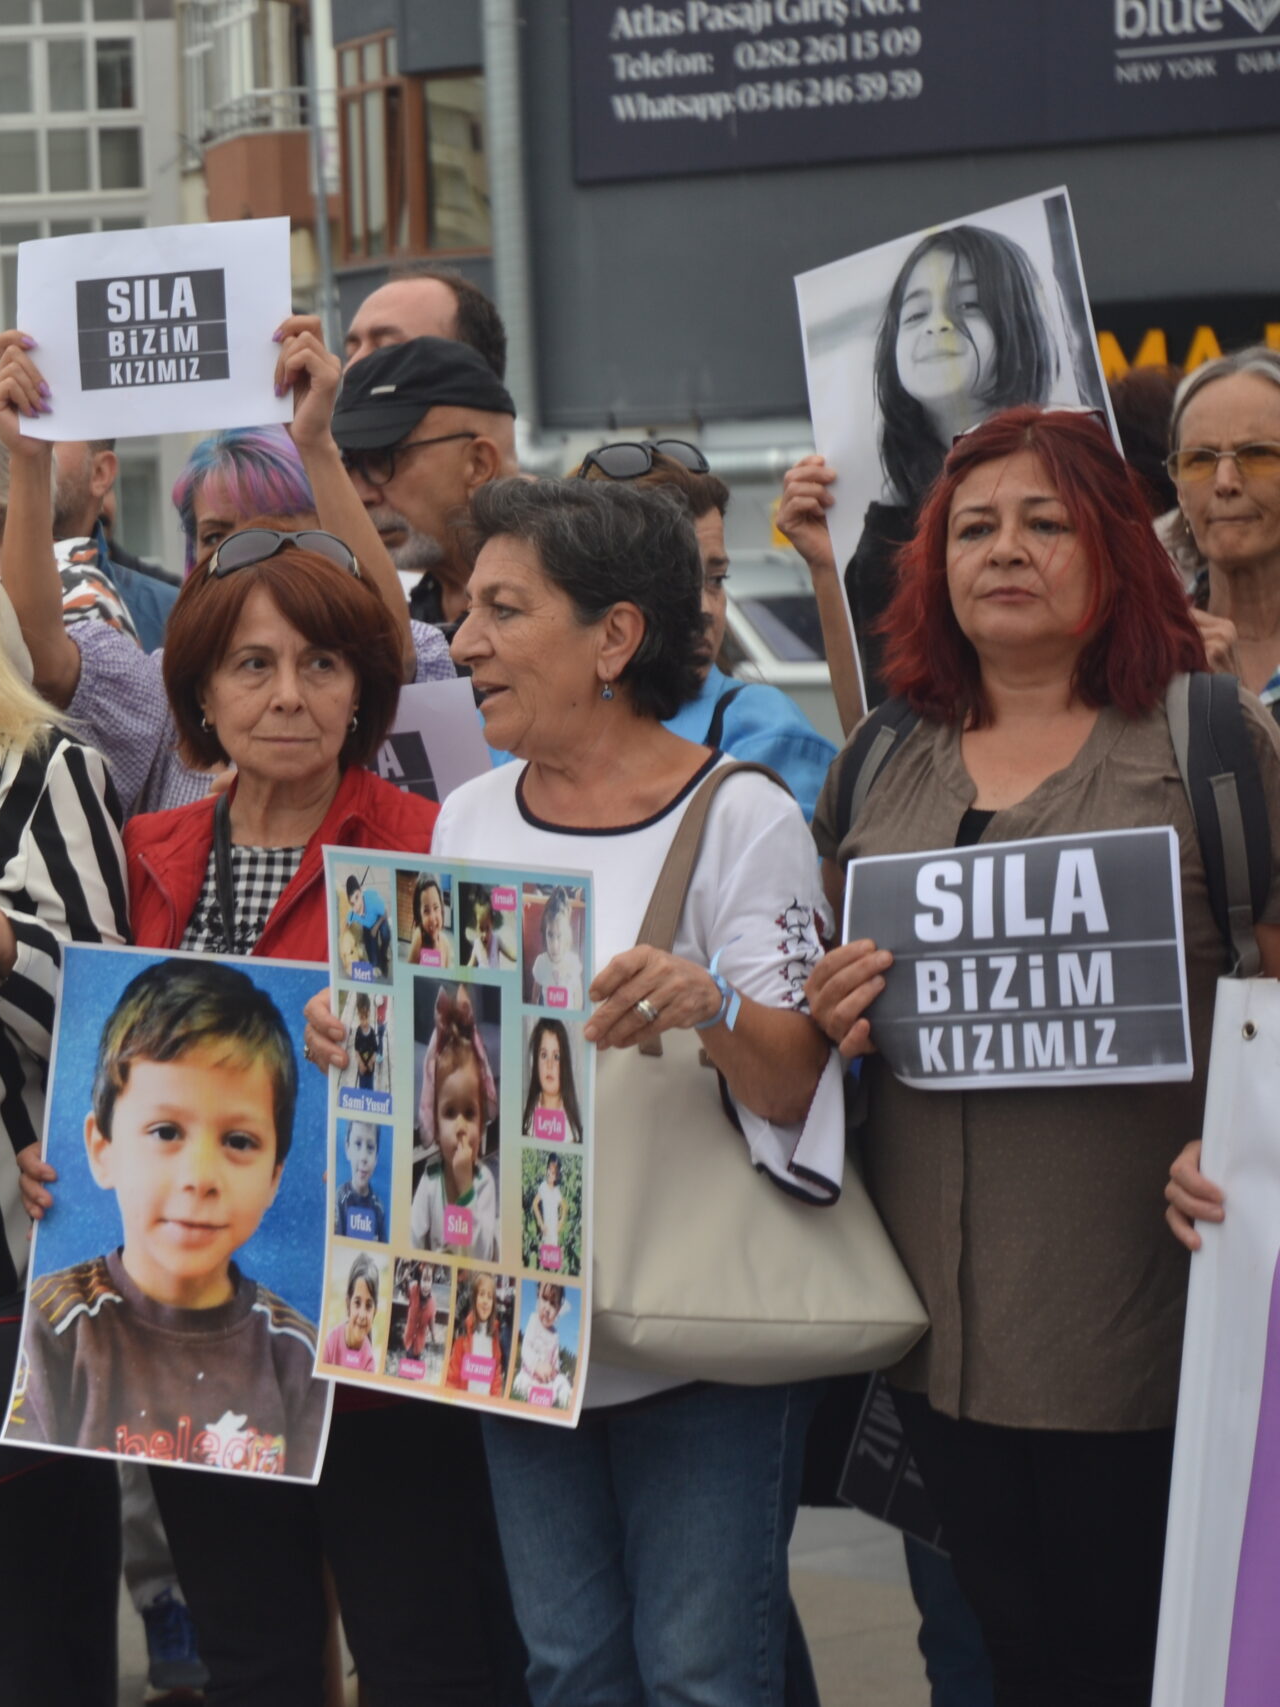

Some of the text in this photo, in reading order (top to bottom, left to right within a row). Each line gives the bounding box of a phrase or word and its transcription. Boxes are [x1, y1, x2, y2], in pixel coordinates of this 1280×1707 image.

[610, 3, 687, 40] Atlas
[1115, 0, 1224, 39] blue
[610, 26, 922, 81] Telefon: 0282 261 15 09
[1116, 61, 1162, 83] NEW
[1166, 55, 1218, 79] YORK
[107, 276, 197, 323] SILA
[110, 357, 200, 385] KIZIMIZ
[914, 847, 1110, 943] SILA
[354, 967, 372, 981] Mert
[918, 1018, 1119, 1073] KIZIMIZ
[342, 1094, 390, 1113] Sami Yusuf
[538, 1116, 562, 1136] Leyla
[350, 1214, 372, 1232] Ufuk
[448, 1215, 468, 1235] Sıla
